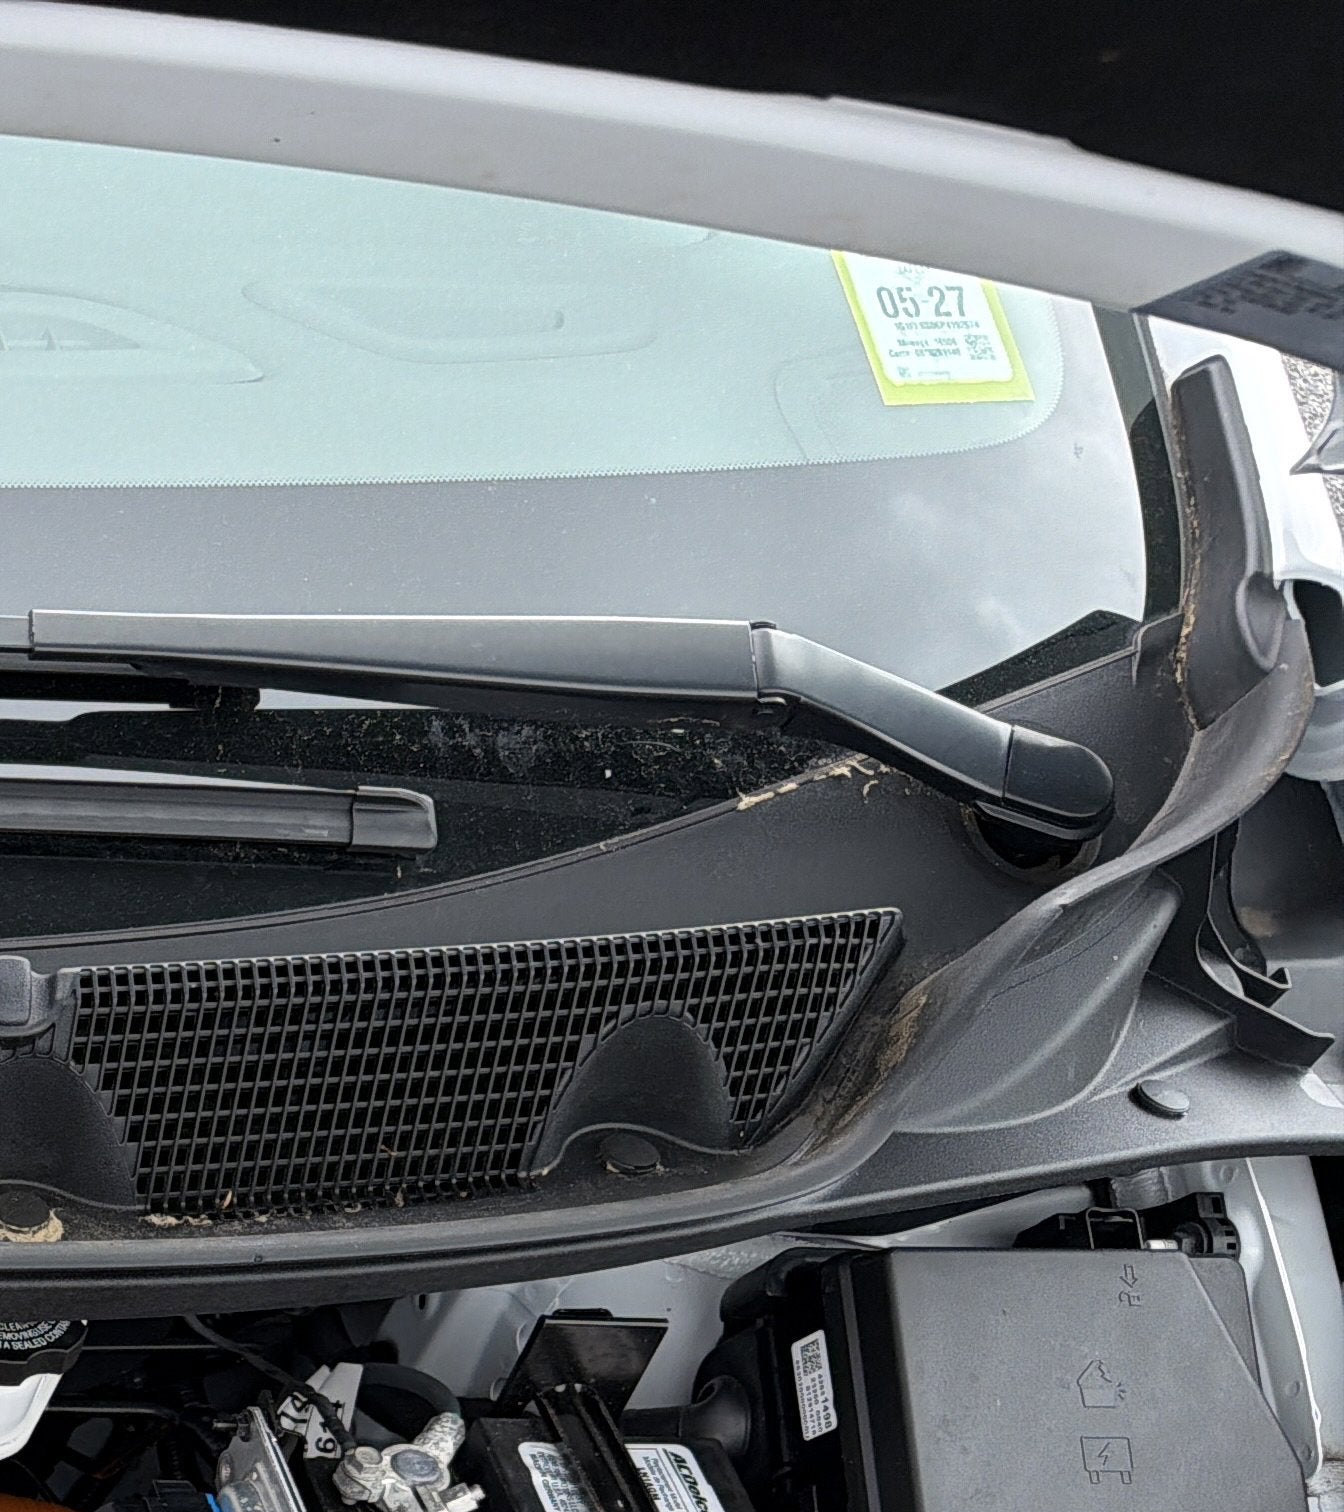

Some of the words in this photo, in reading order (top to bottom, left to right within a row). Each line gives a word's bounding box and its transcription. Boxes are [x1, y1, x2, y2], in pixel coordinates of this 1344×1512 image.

[876, 285, 968, 319] 05-27
[4, 1341, 10, 1349] A
[12, 1337, 47, 1350] SEALED
